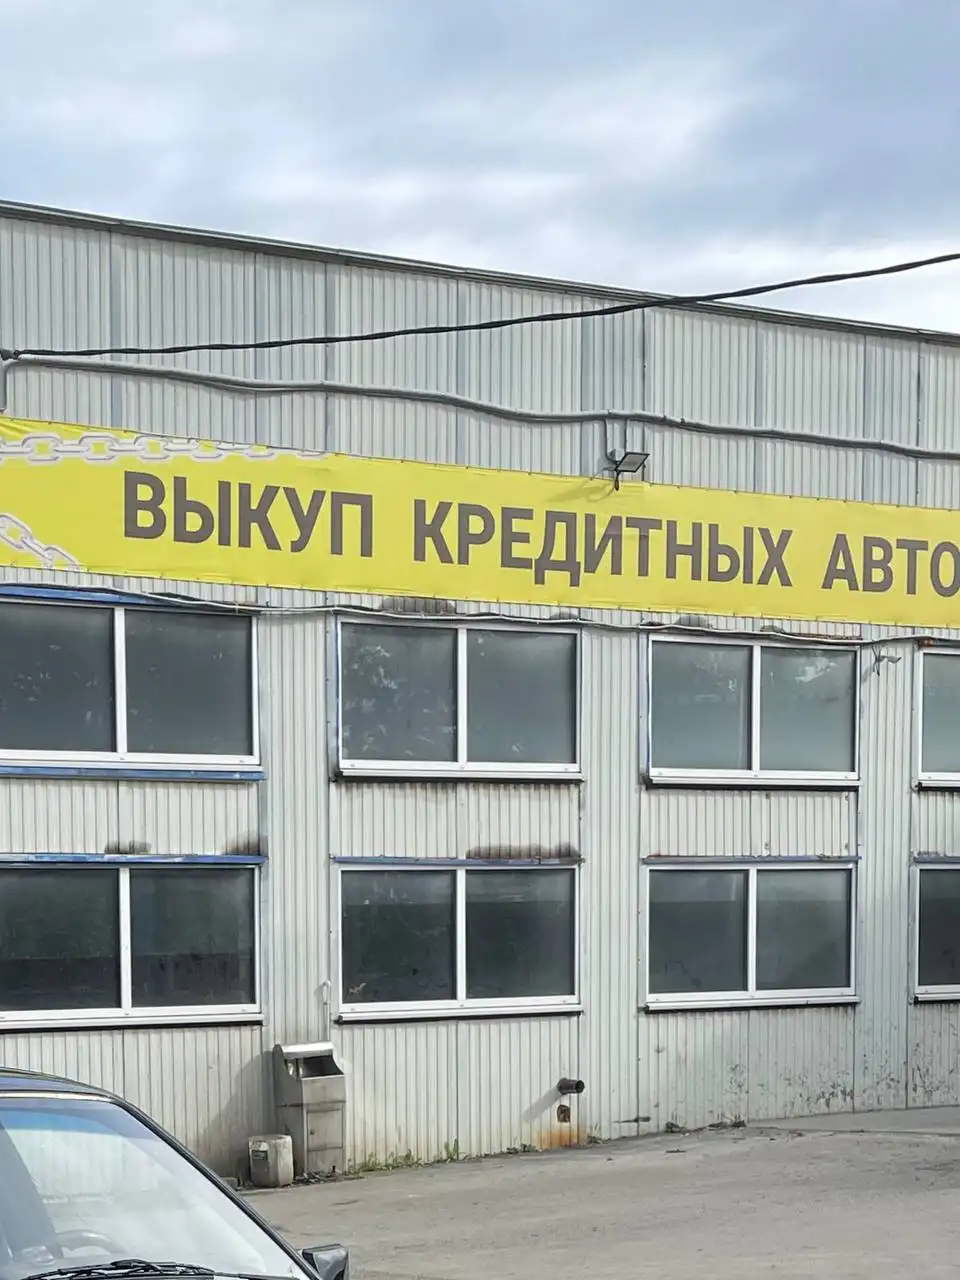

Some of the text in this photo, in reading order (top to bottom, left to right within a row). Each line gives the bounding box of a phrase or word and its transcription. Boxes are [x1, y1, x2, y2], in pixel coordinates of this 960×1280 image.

[123, 470, 960, 598] ВЫКУП КРЕДИТНЫХ АВТО
